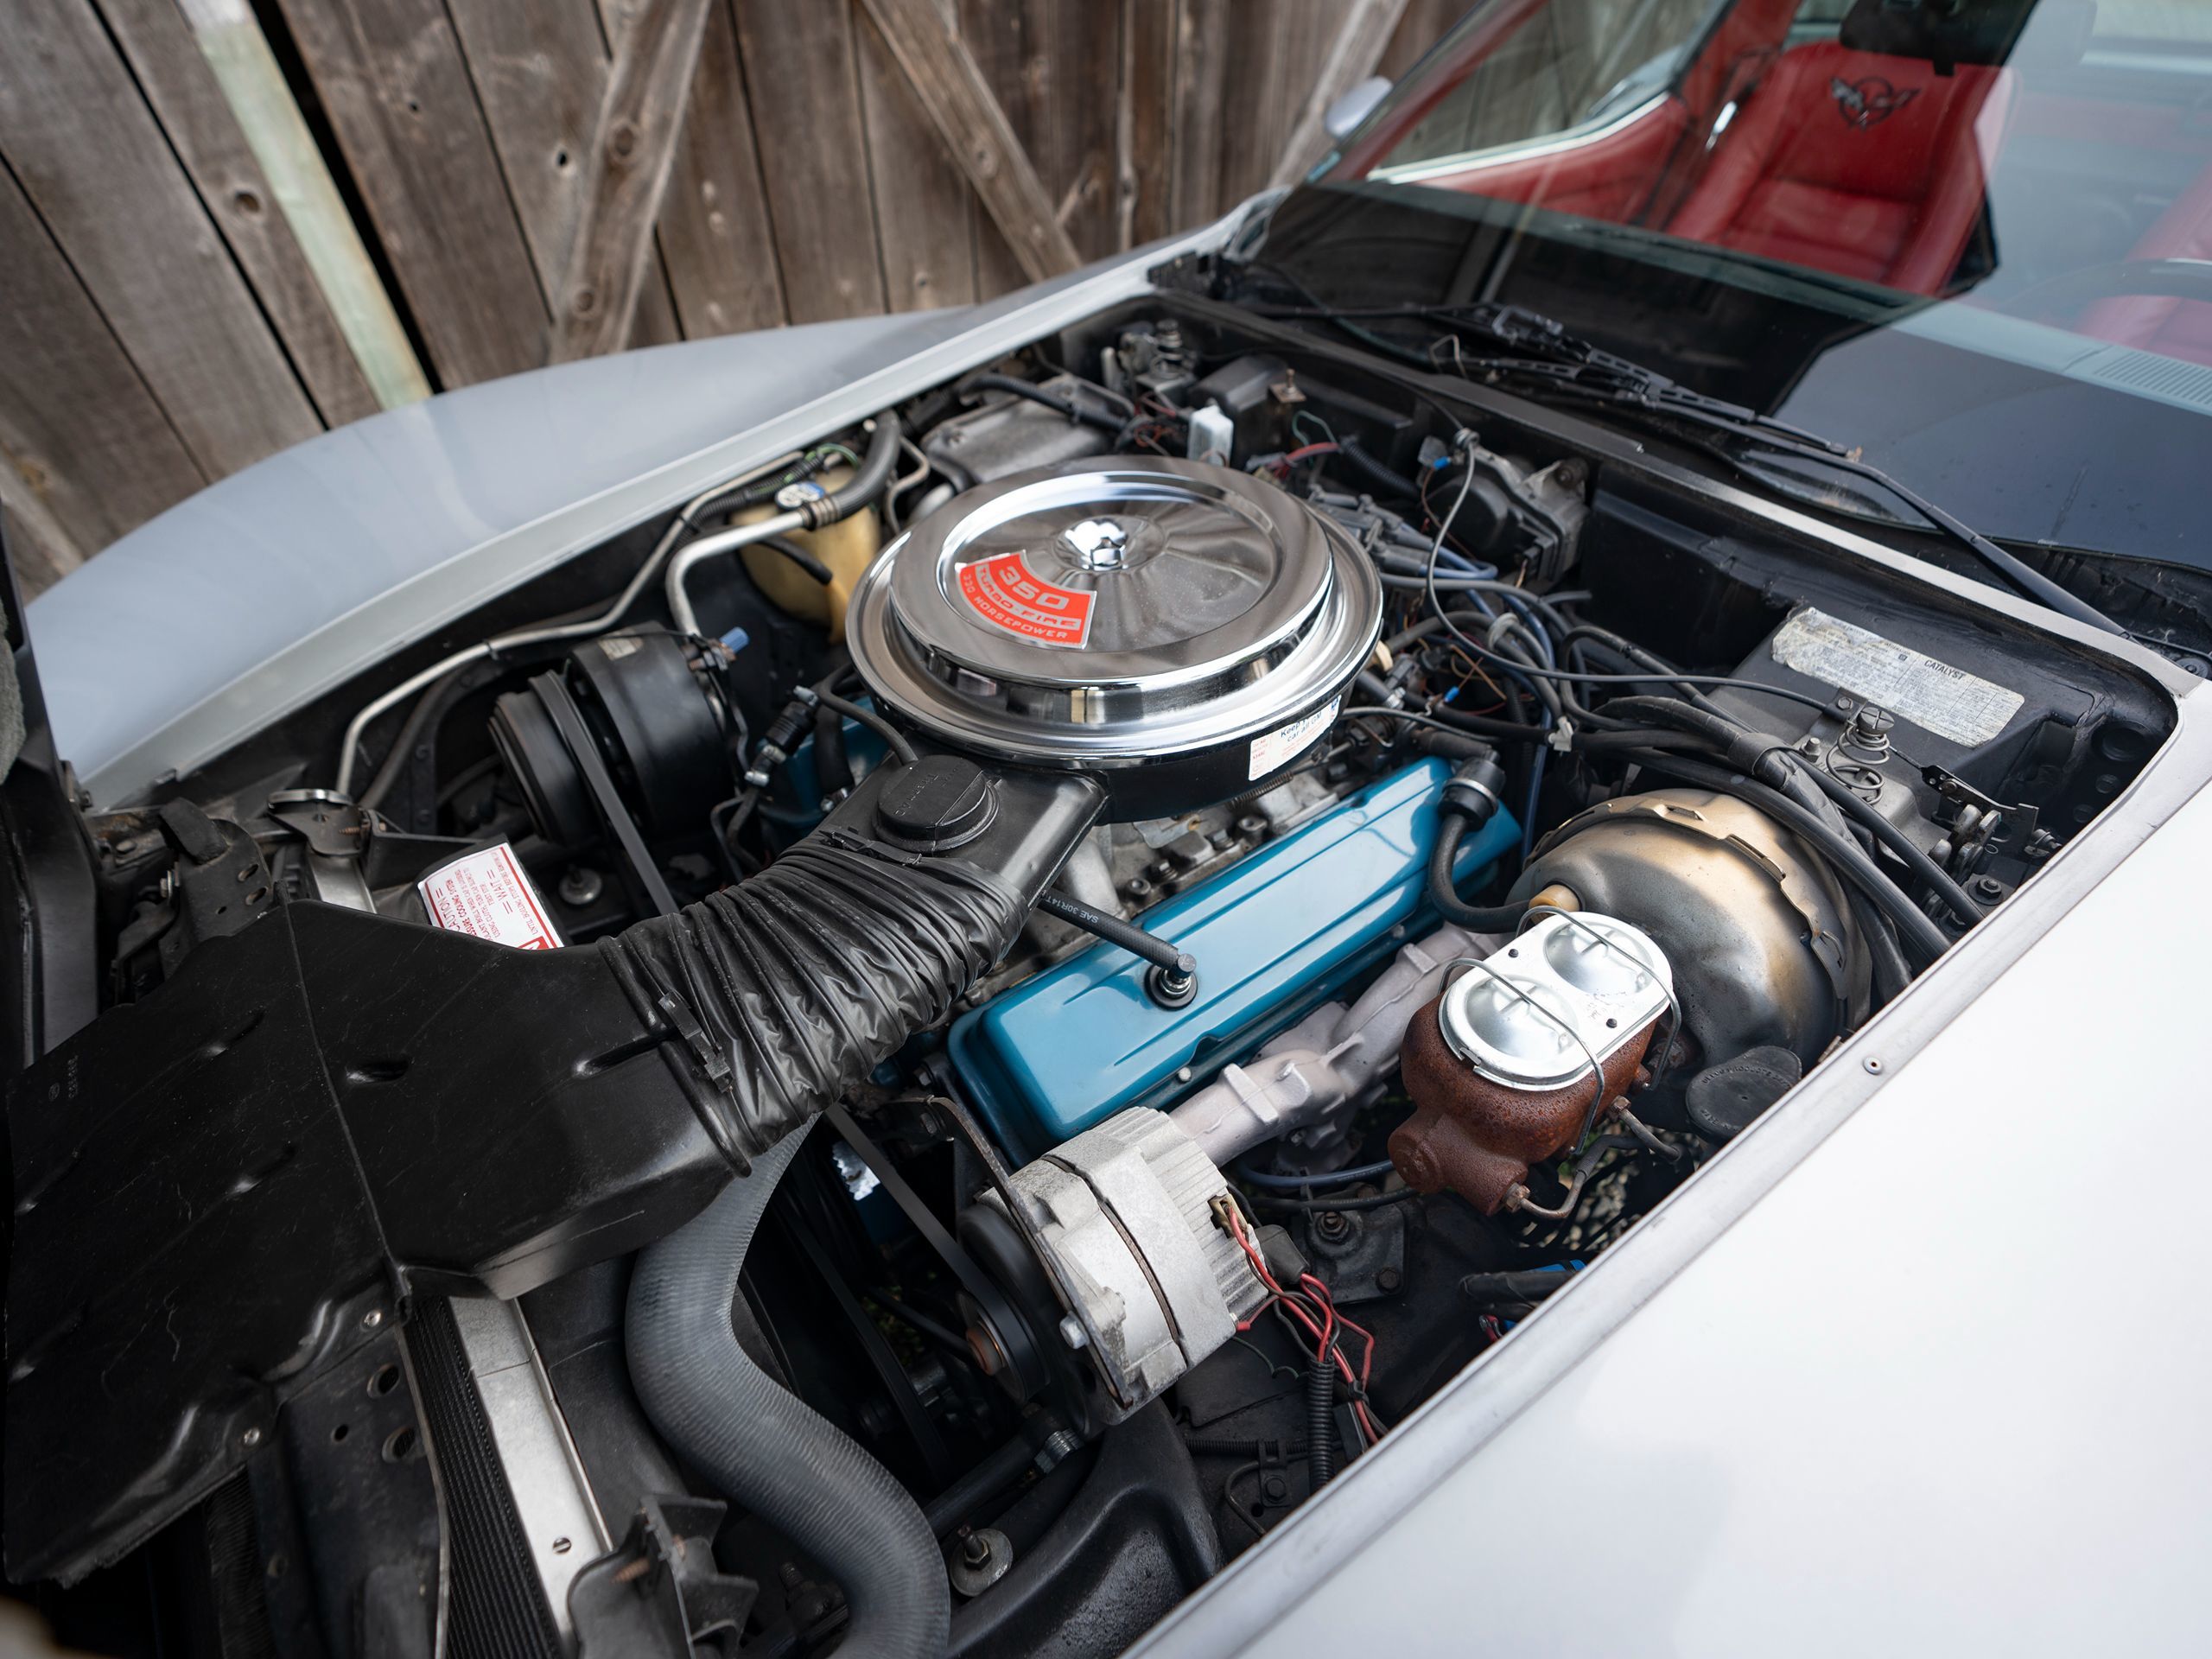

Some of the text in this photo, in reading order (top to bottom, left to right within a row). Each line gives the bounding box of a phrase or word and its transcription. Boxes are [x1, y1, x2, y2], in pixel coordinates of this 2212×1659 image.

[999, 566, 1069, 610] 350
[974, 596, 1068, 639] HORSEPOWER
[1924, 659, 1967, 680] CATALYST
[490, 880, 507, 901] WAIT
[1079, 912, 1099, 924] SAE
